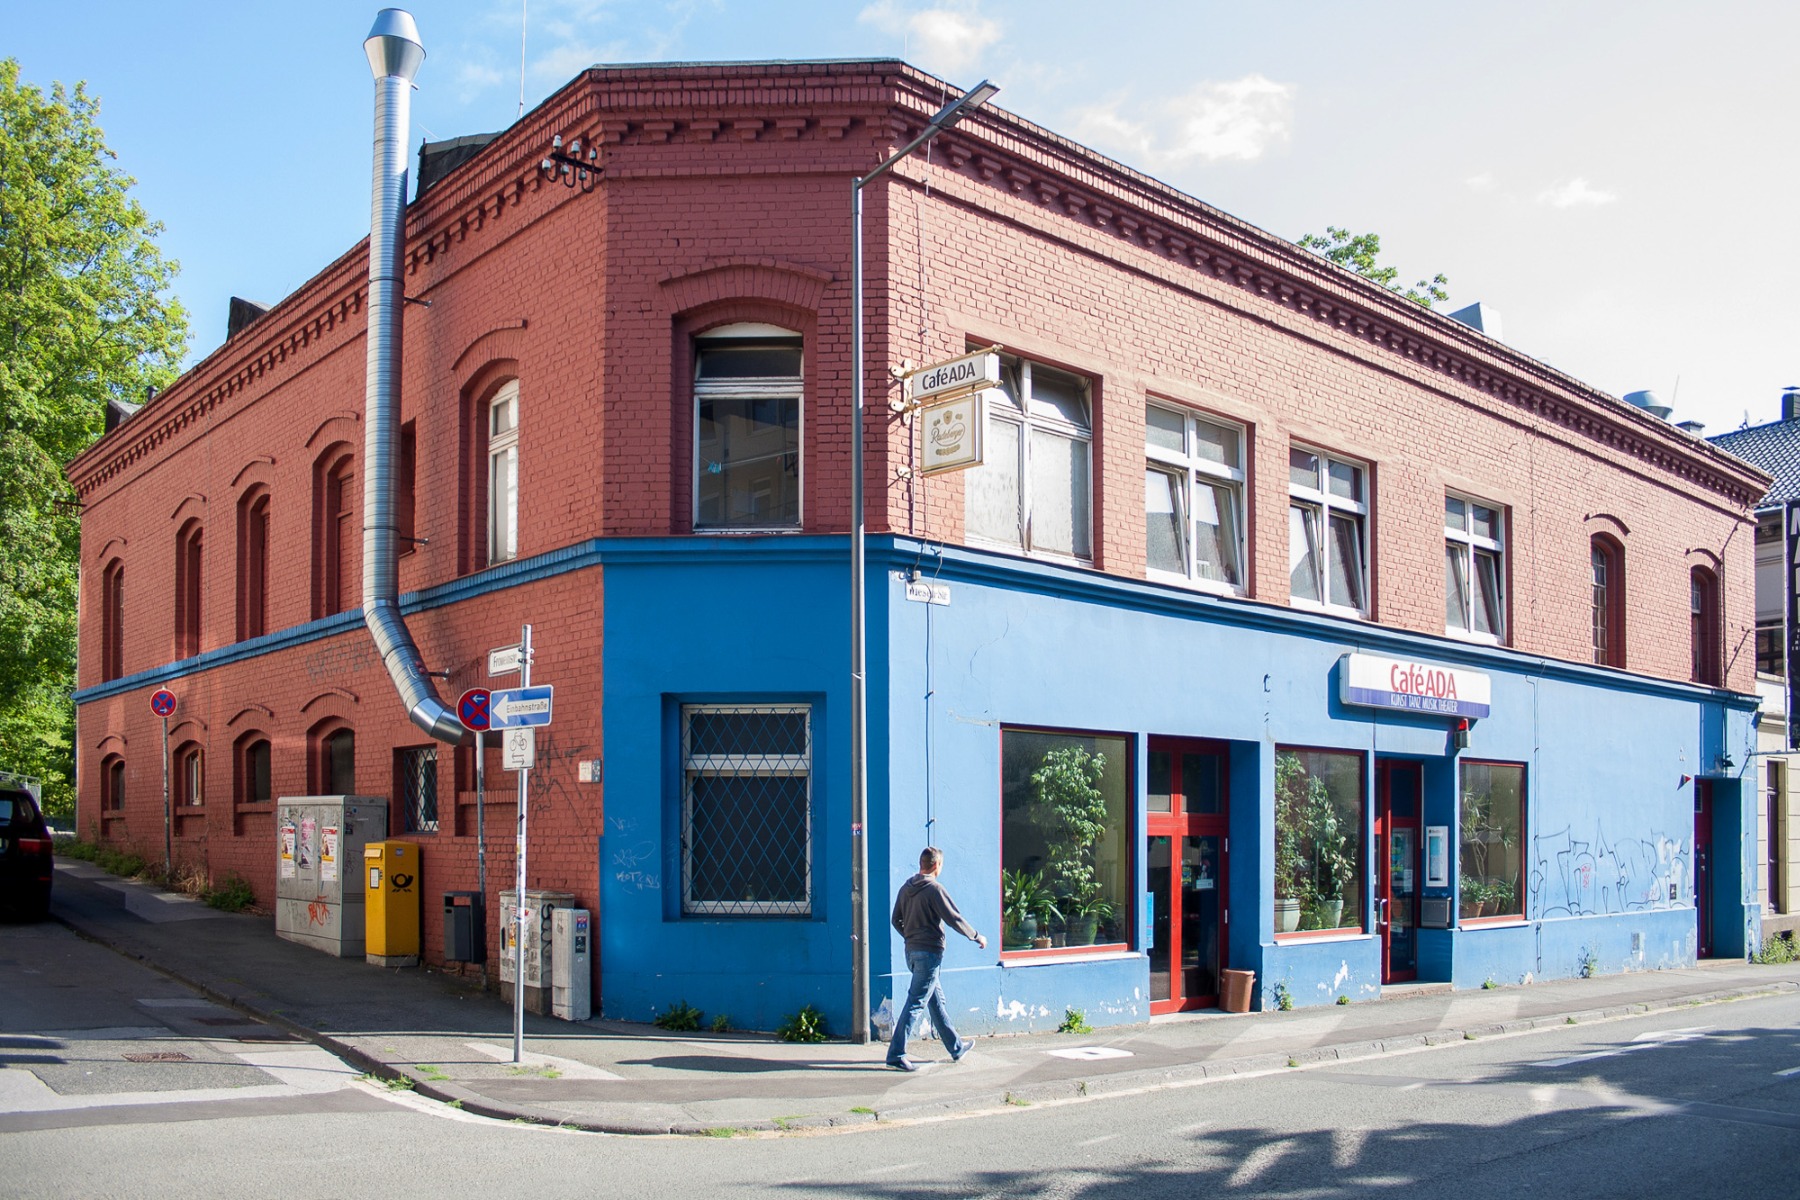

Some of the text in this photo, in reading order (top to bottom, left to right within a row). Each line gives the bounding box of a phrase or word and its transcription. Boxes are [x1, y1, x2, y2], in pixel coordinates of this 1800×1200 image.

[506, 701, 548, 714] Einbahnstraße
[1390, 693, 1458, 713] KUNST TANZ MUSIK THEATER
